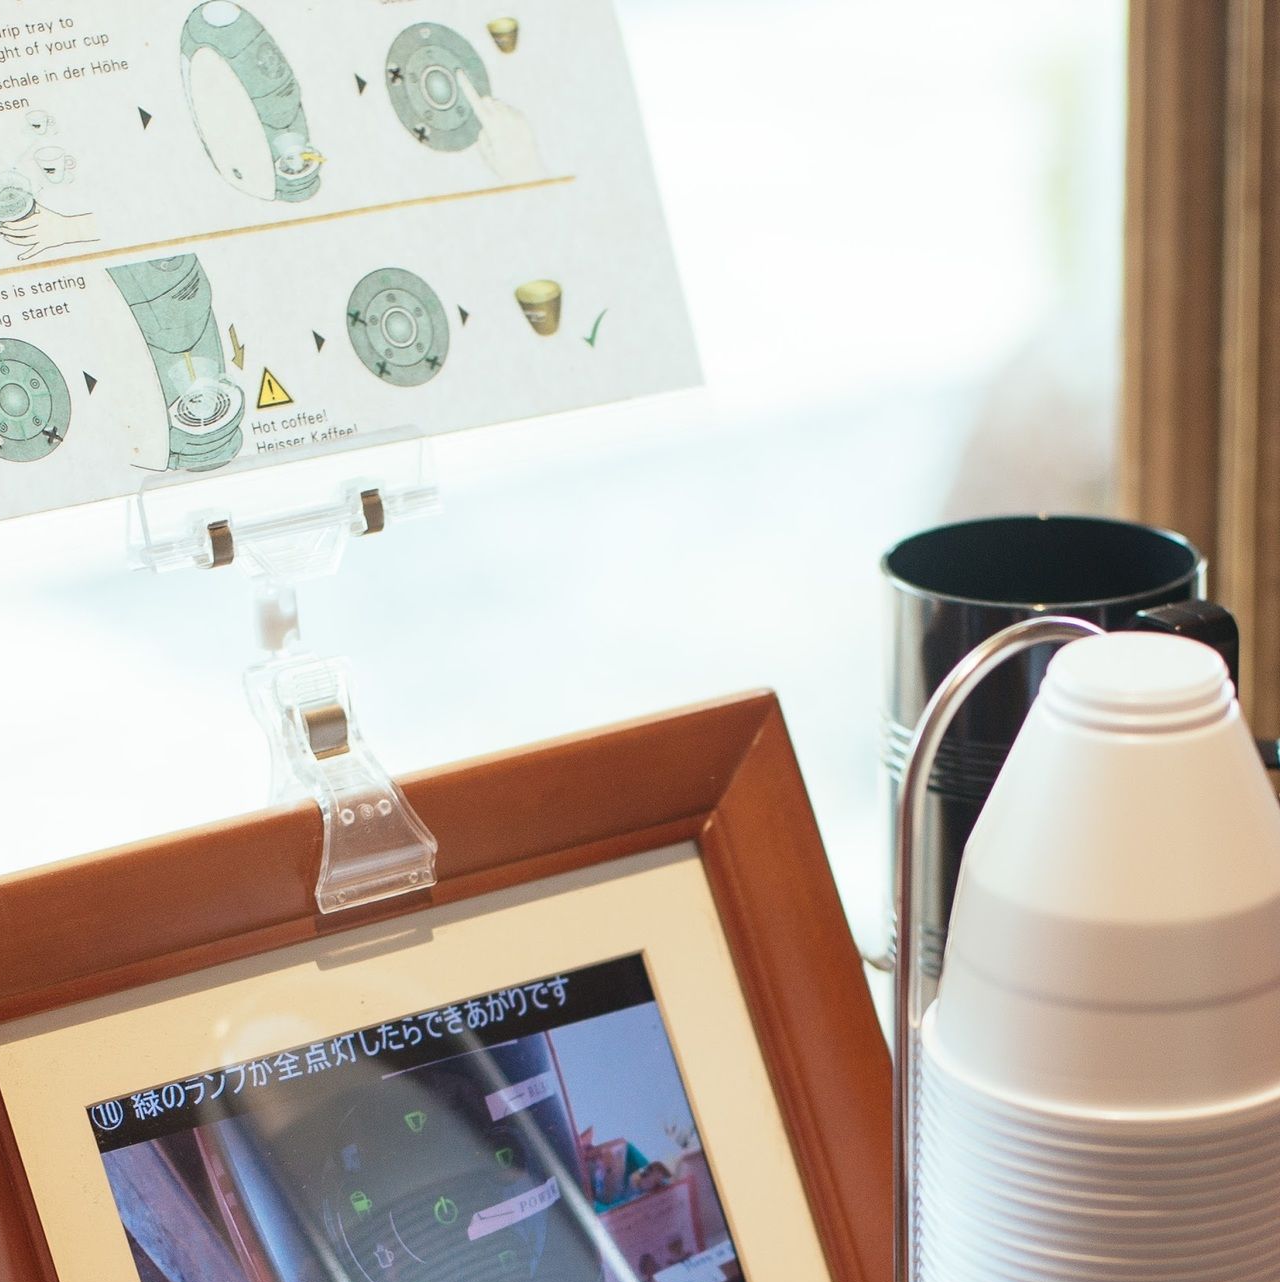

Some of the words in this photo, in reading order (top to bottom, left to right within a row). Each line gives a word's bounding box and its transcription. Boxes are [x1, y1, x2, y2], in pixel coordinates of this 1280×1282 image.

[25, 22, 53, 34] tray
[59, 18, 74, 28] to
[25, 41, 40, 55] of
[45, 38, 76, 55] your
[83, 33, 110, 47] cup
[44, 70, 59, 82] in
[63, 66, 86, 79] der
[90, 59, 129, 74] Höhe
[13, 284, 26, 298] is
[30, 274, 86, 295] starting
[21, 301, 71, 321] startet
[251, 421, 277, 435] Hot
[281, 409, 328, 429] coffee!
[131, 975, 569, 1120] 緑のランプが全点灯したらできあがりです
